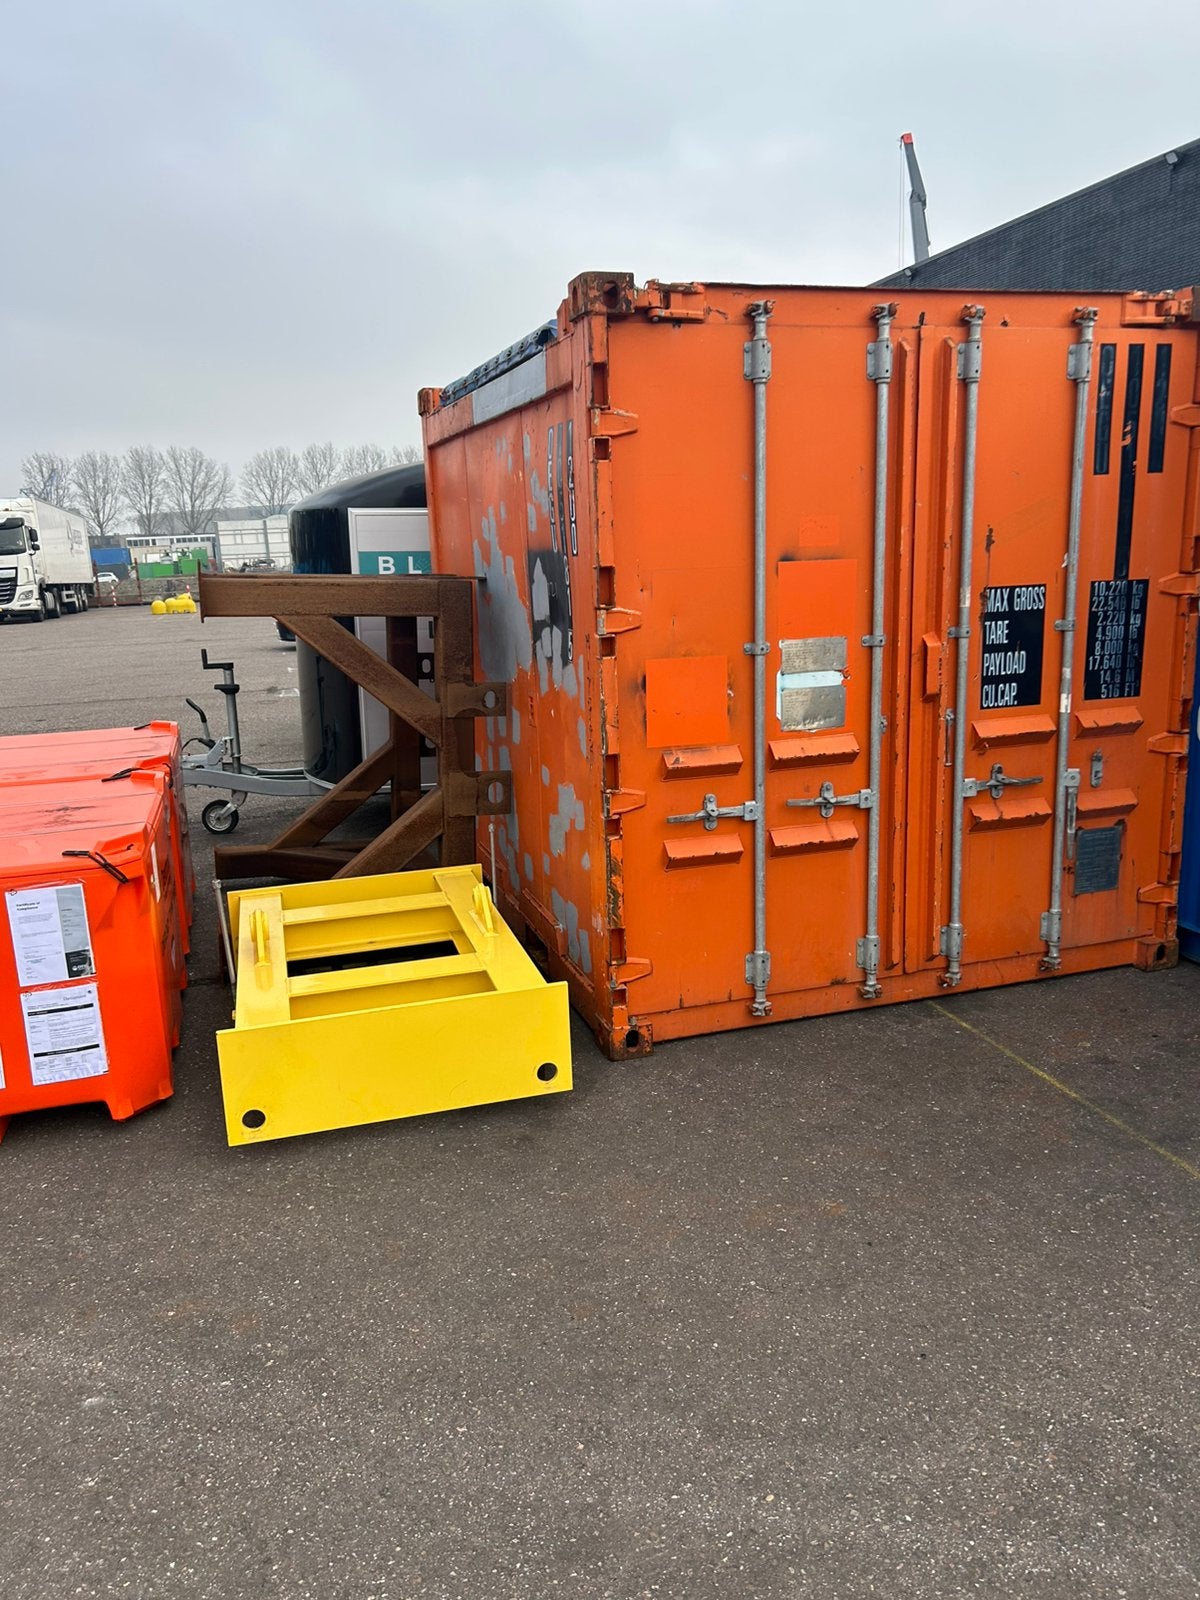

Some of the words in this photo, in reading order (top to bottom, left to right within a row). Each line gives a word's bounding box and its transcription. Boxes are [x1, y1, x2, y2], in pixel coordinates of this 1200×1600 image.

[985, 588, 1010, 613] MAX
[1014, 586, 1045, 611] GROSS
[1132, 580, 1144, 598] kg
[1130, 610, 1141, 627] kg
[984, 620, 1010, 645] TARE
[983, 650, 1026, 676] PAYLOAD
[982, 682, 1018, 708] CU.CAP.
[1101, 684, 1120, 698] 516
